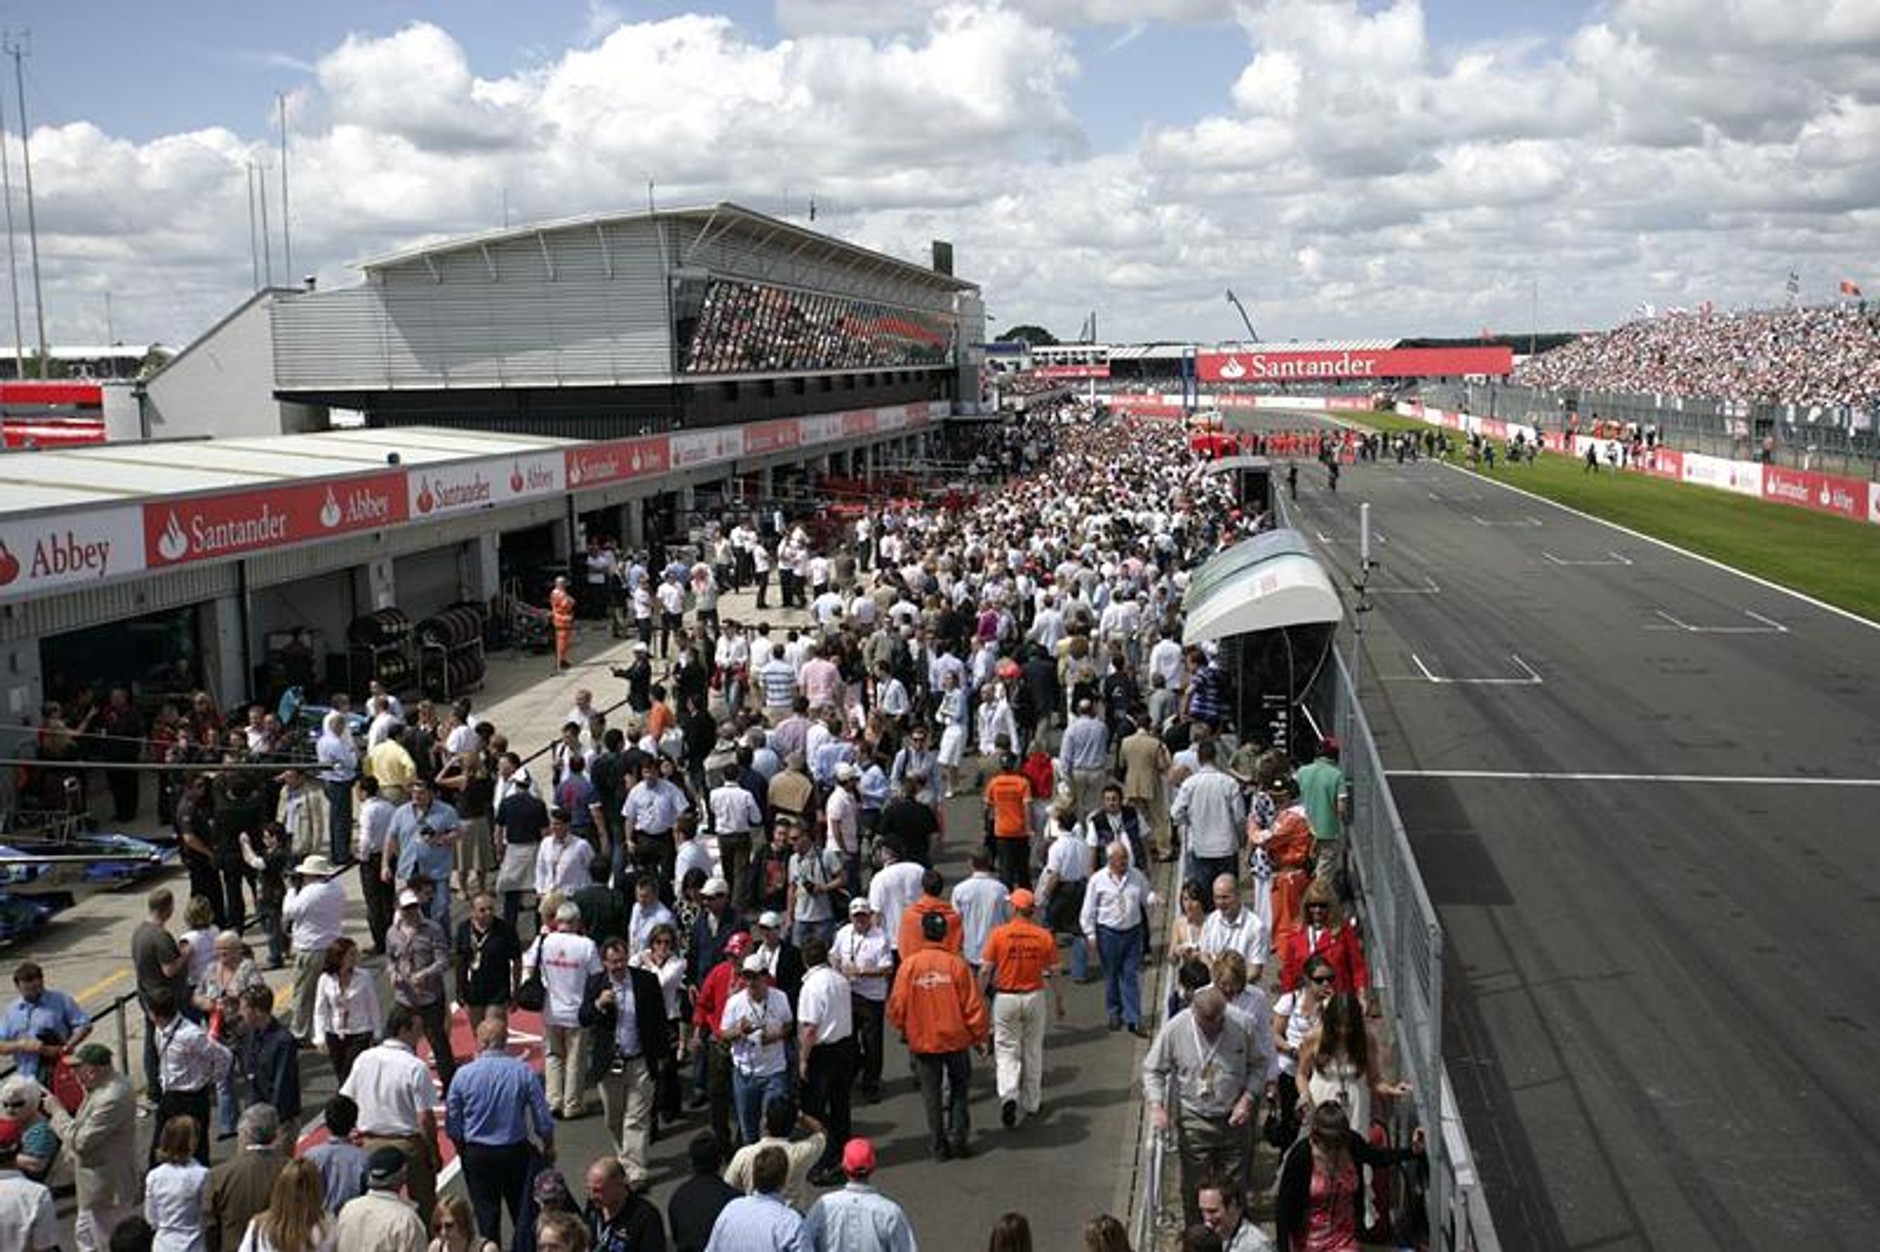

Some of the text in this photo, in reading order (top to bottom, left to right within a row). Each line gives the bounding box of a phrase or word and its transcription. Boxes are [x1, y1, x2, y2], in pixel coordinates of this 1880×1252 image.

[1252, 352, 1375, 377] Santander
[435, 461, 553, 508] Santander Abbey
[191, 488, 389, 552] Santander Abbey
[30, 528, 110, 577] Abbey
